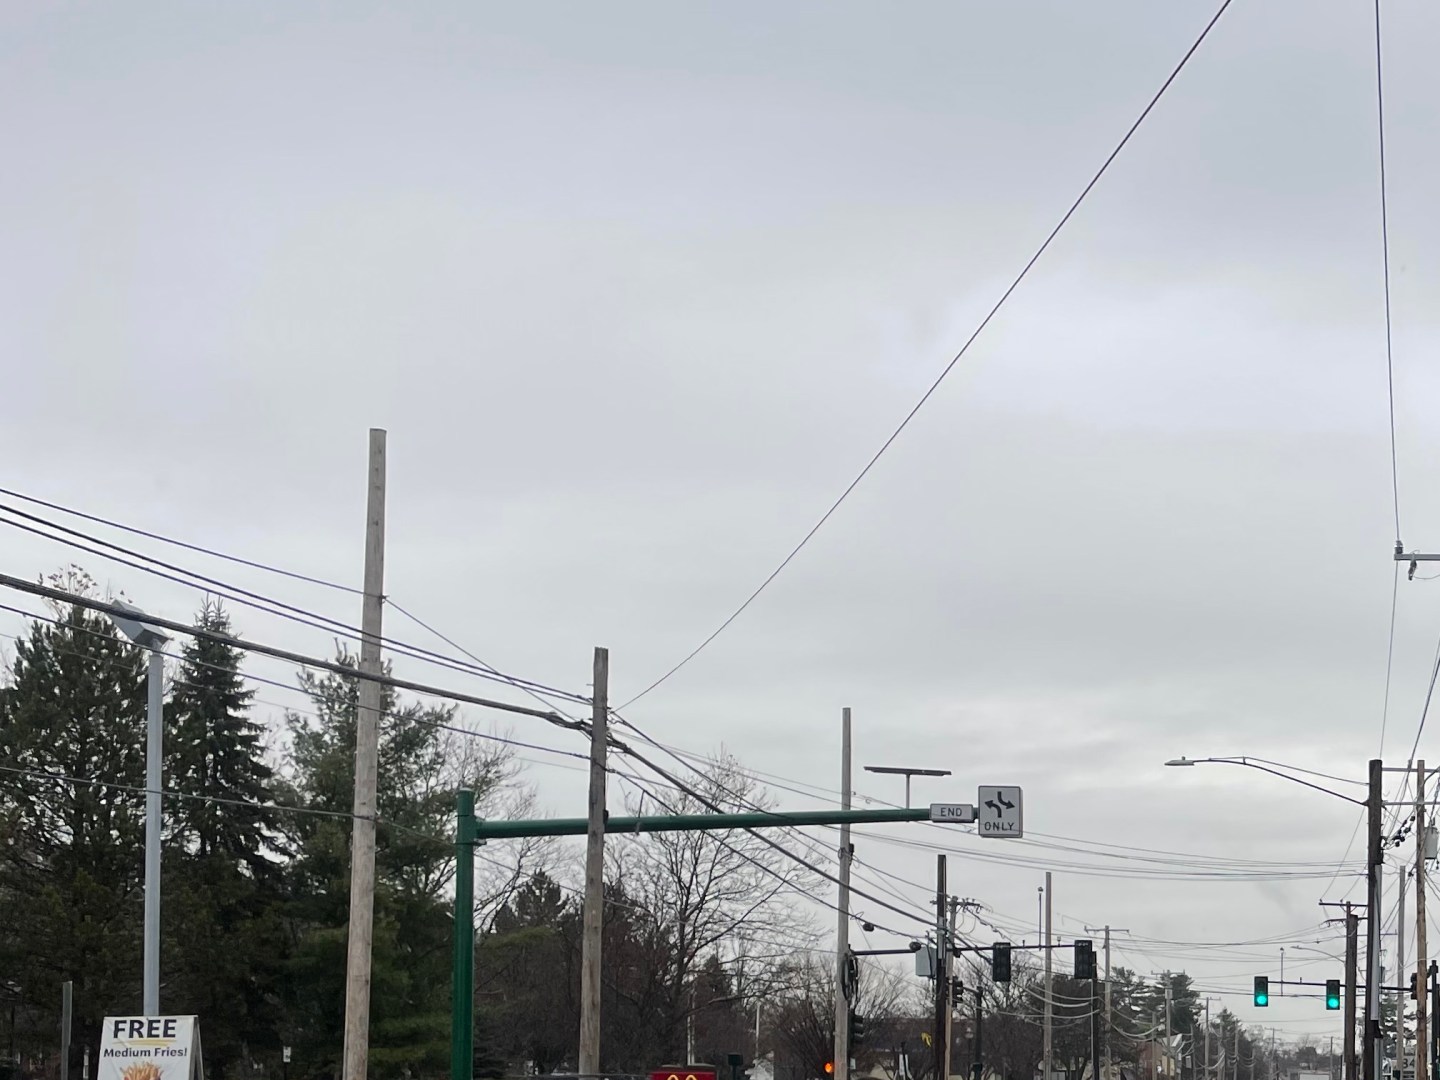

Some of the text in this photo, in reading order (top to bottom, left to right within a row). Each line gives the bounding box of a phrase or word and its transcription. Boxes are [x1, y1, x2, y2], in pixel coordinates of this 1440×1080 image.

[940, 807, 962, 817] END
[984, 821, 1014, 831] ONLY
[113, 1019, 177, 1038] FREE
[103, 1047, 187, 1057] Medium Fries!
